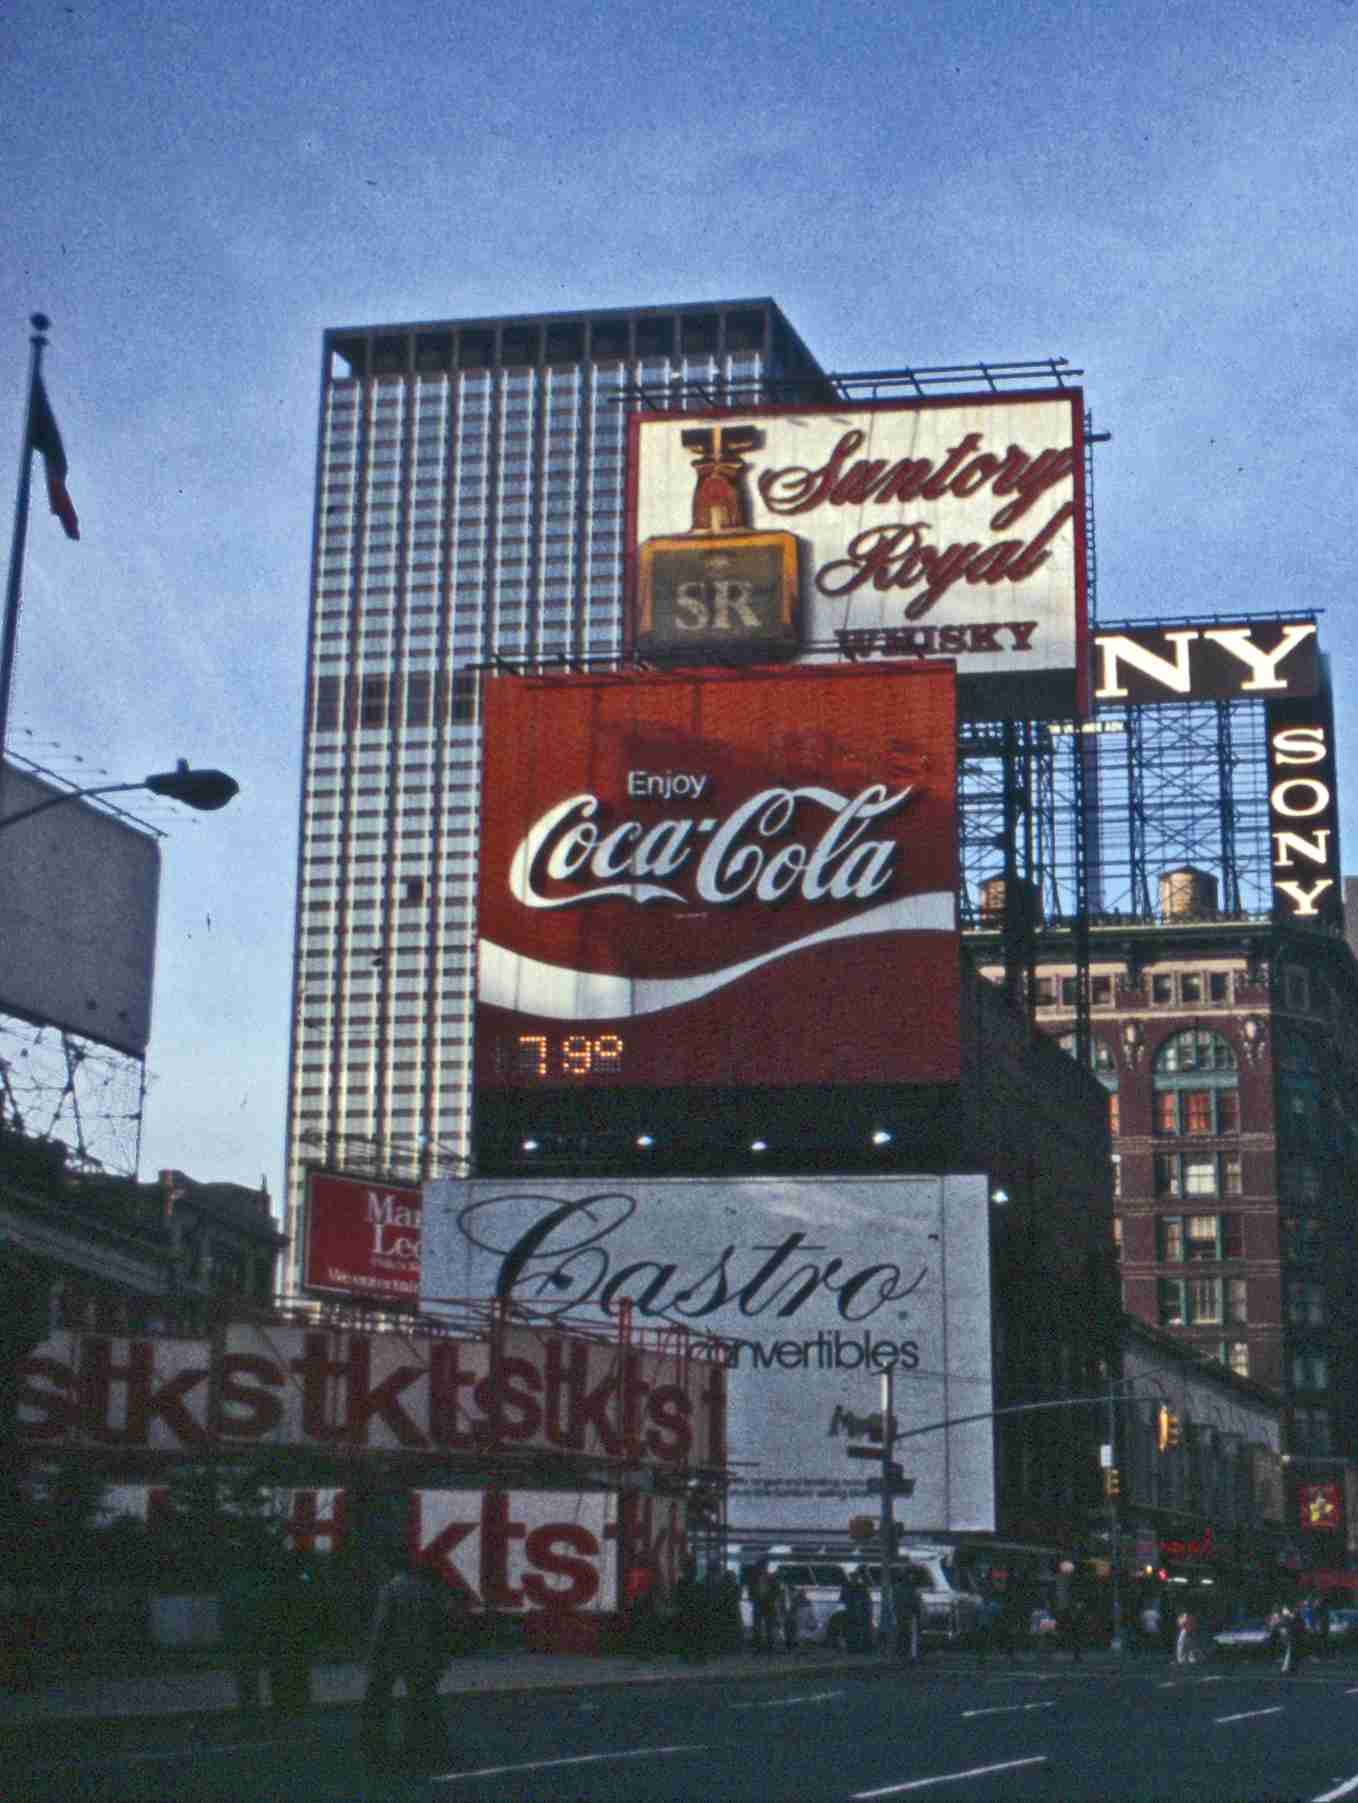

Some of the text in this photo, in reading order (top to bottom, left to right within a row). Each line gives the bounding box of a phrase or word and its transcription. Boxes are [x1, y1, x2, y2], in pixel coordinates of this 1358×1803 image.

[759, 428, 1075, 530] Suntory
[675, 580, 762, 632] SR
[817, 502, 1075, 619] Royal
[834, 620, 1039, 656] WHISKY
[627, 769, 709, 801] Enjoy
[1271, 727, 1329, 917] SONY
[508, 784, 915, 908] Coca-Cola
[456, 1193, 929, 1322] Castro
